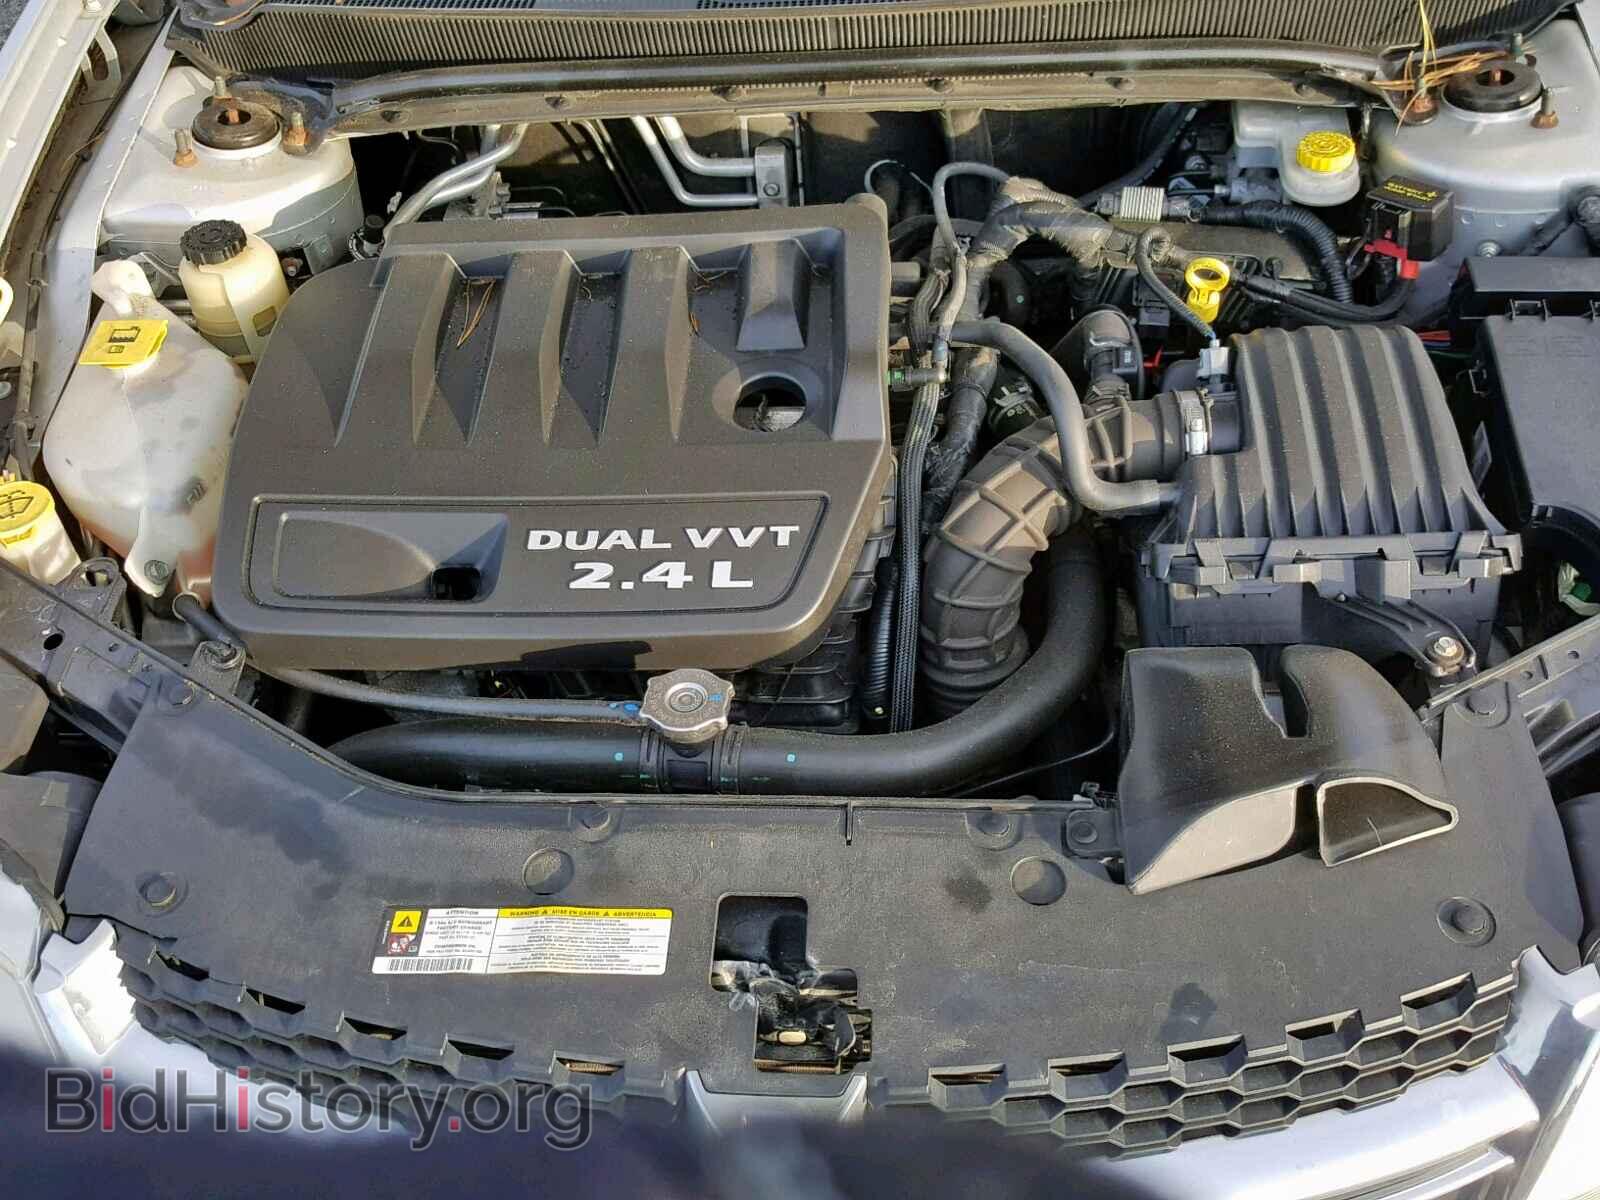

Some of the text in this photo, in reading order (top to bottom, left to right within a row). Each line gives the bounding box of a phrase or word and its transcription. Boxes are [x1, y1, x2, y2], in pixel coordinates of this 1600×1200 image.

[526, 525, 801, 551] DUAL VVT
[568, 560, 754, 590] 2.4 L
